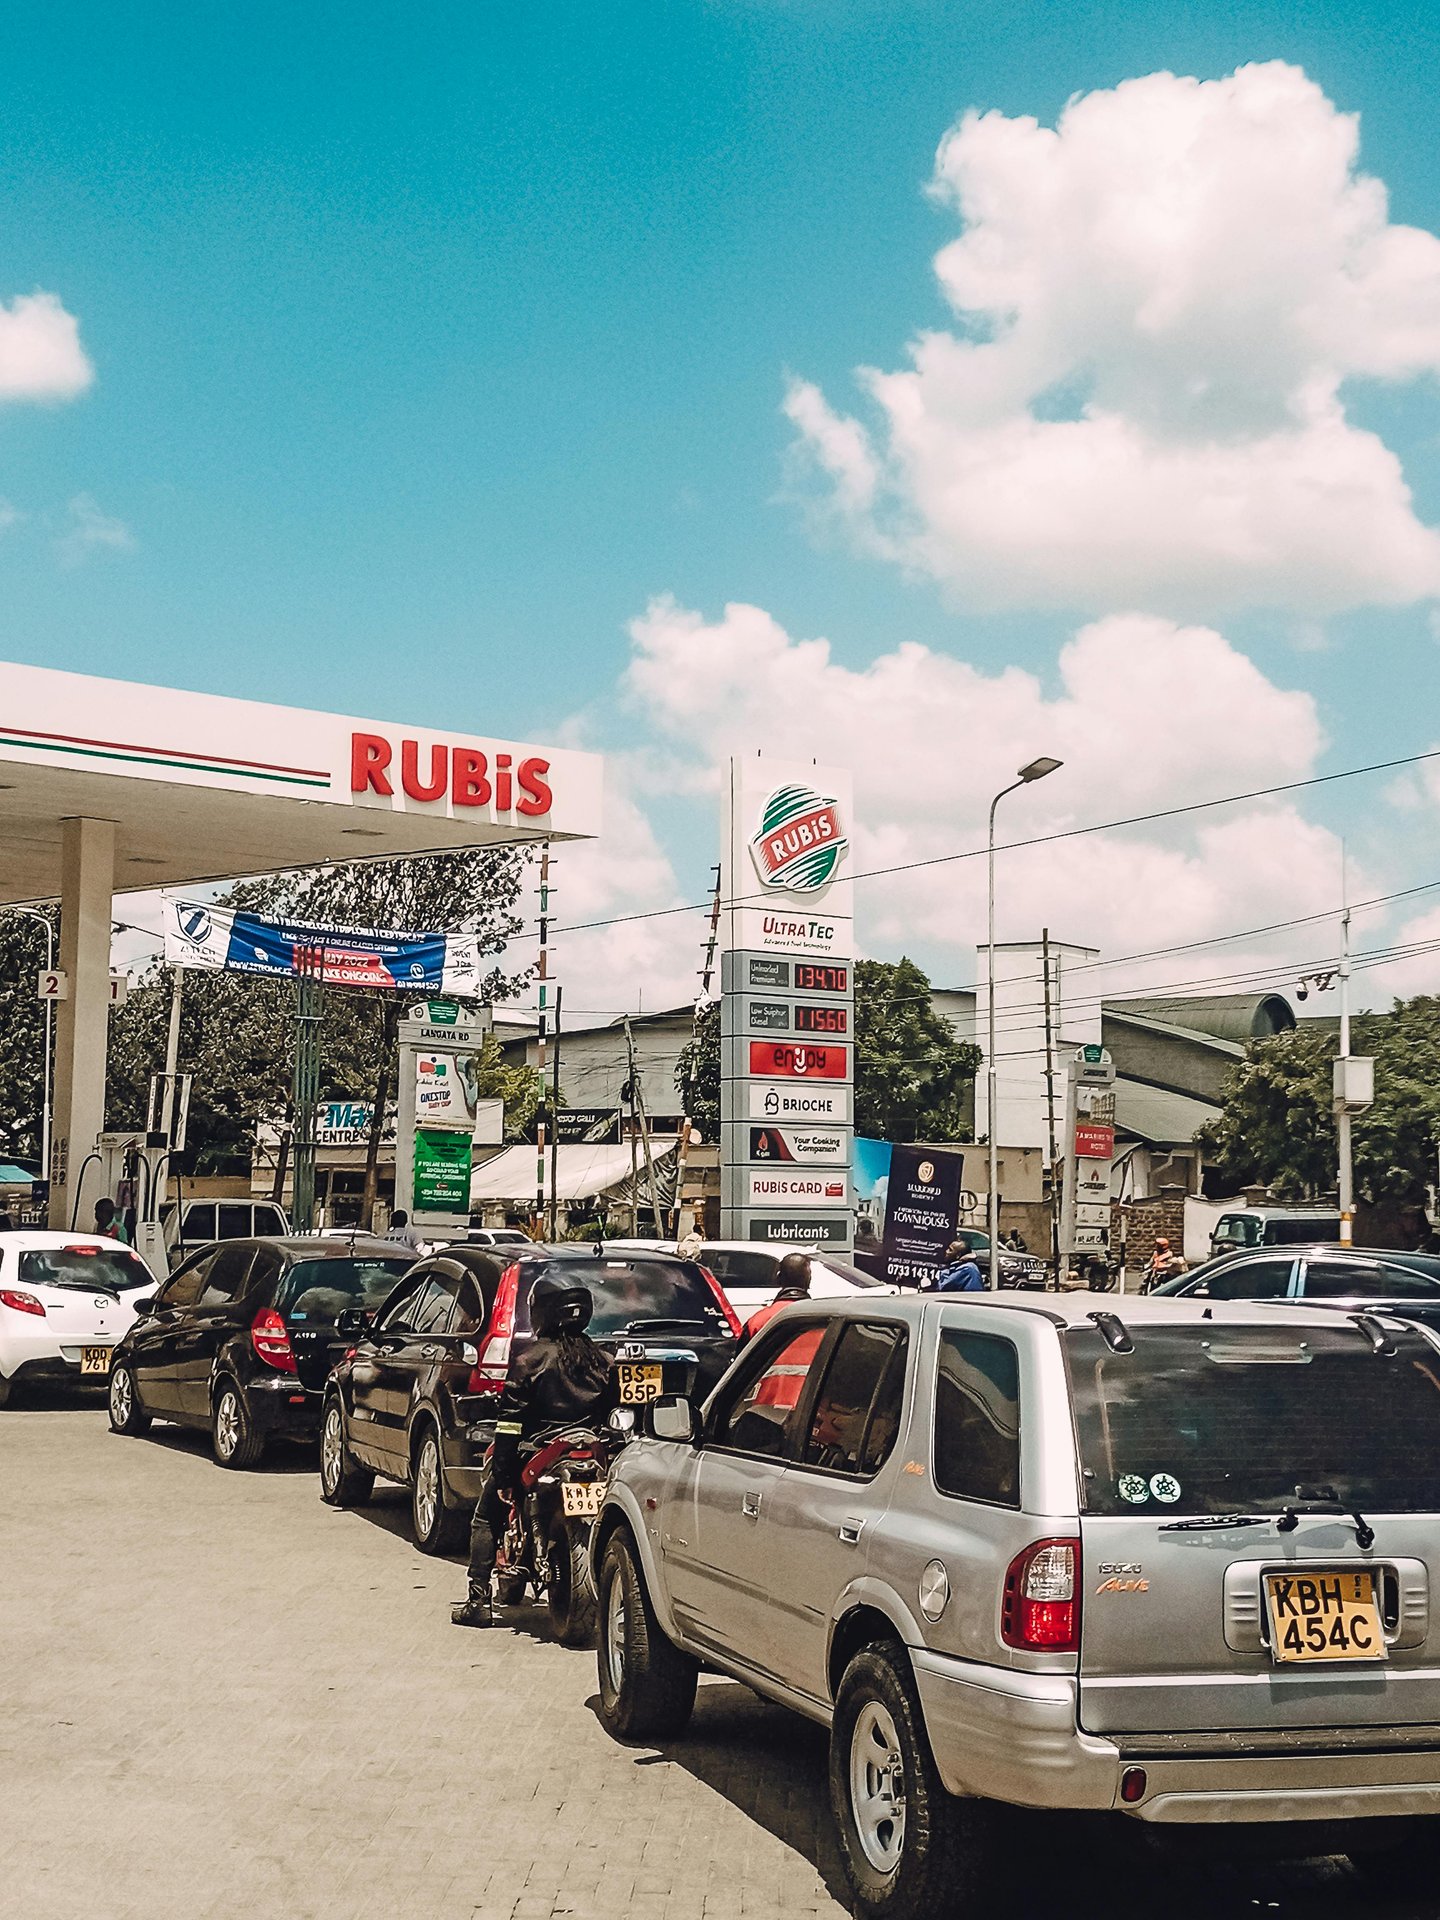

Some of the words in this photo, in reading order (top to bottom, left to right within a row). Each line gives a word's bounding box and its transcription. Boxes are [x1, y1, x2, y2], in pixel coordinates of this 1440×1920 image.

[351, 733, 553, 816] RUBiS
[770, 815, 832, 862] RUBiS
[344, 956, 368, 967] 2022
[342, 970, 387, 982] ONGOING
[46, 976, 58, 994] 2
[111, 982, 118, 999] 1
[459, 1031, 469, 1041] RD
[783, 1099, 832, 1112] BRIOCHE
[793, 1136, 810, 1144] Your
[812, 1136, 840, 1147] Cooking
[797, 1145, 837, 1154] Companion
[790, 1182, 822, 1194] CARD
[767, 1223, 829, 1239] Lubricants
[887, 1264, 909, 1277] 0733
[911, 1266, 928, 1279] 143
[86, 1360, 106, 1370] 761
[1099, 1562, 1142, 1574] ISUZU
[1274, 1578, 1344, 1618] KBH
[1284, 1615, 1372, 1655] 454C
